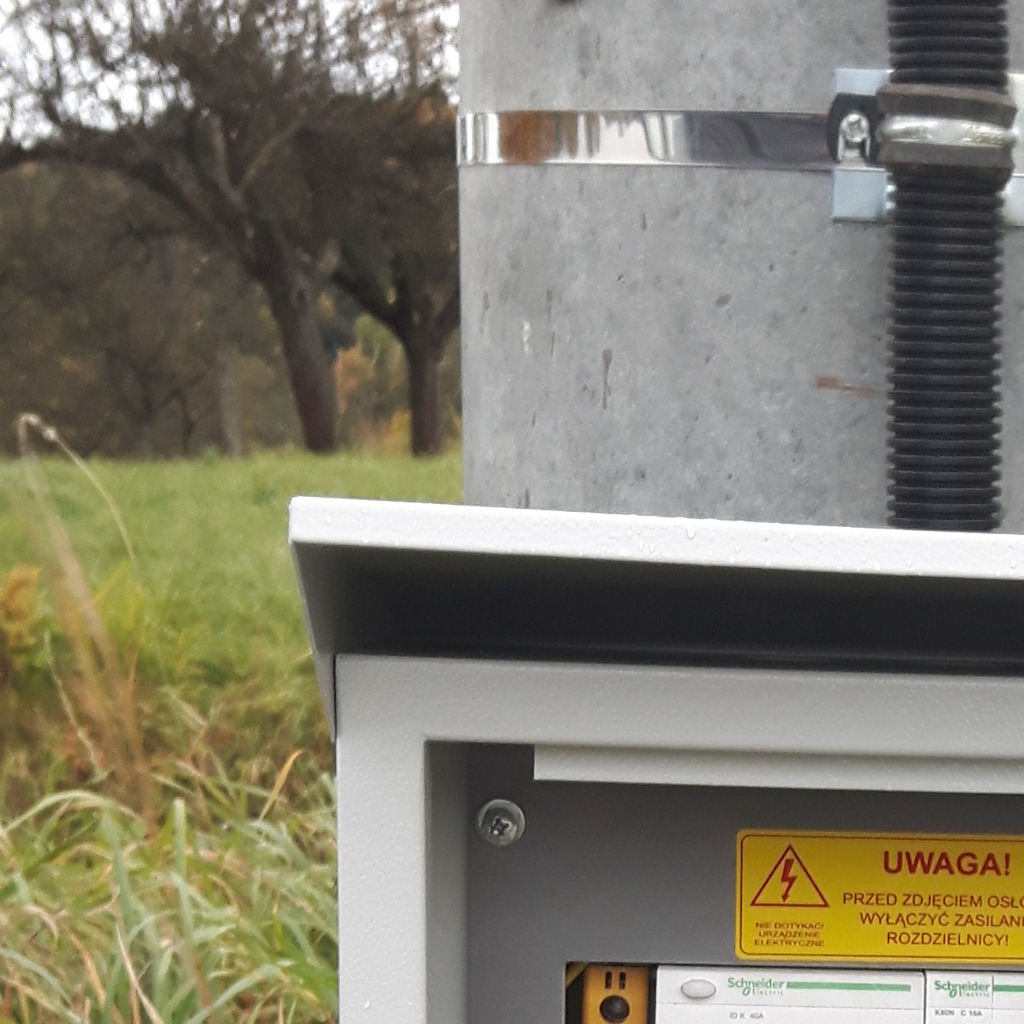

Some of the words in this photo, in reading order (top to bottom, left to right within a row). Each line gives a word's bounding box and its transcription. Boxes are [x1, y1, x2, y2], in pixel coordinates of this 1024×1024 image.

[883, 850, 1011, 876] UWAGA!
[843, 892, 898, 908] PRZED
[902, 893, 983, 911] ZDJĘCIEM
[860, 910, 950, 929] WYŁĄCZYĆ
[886, 931, 1010, 947] ROZDZIELNICY!
[727, 976, 786, 996] Schneider
[934, 979, 991, 998] Schneider
[960, 1009, 967, 1017] C
